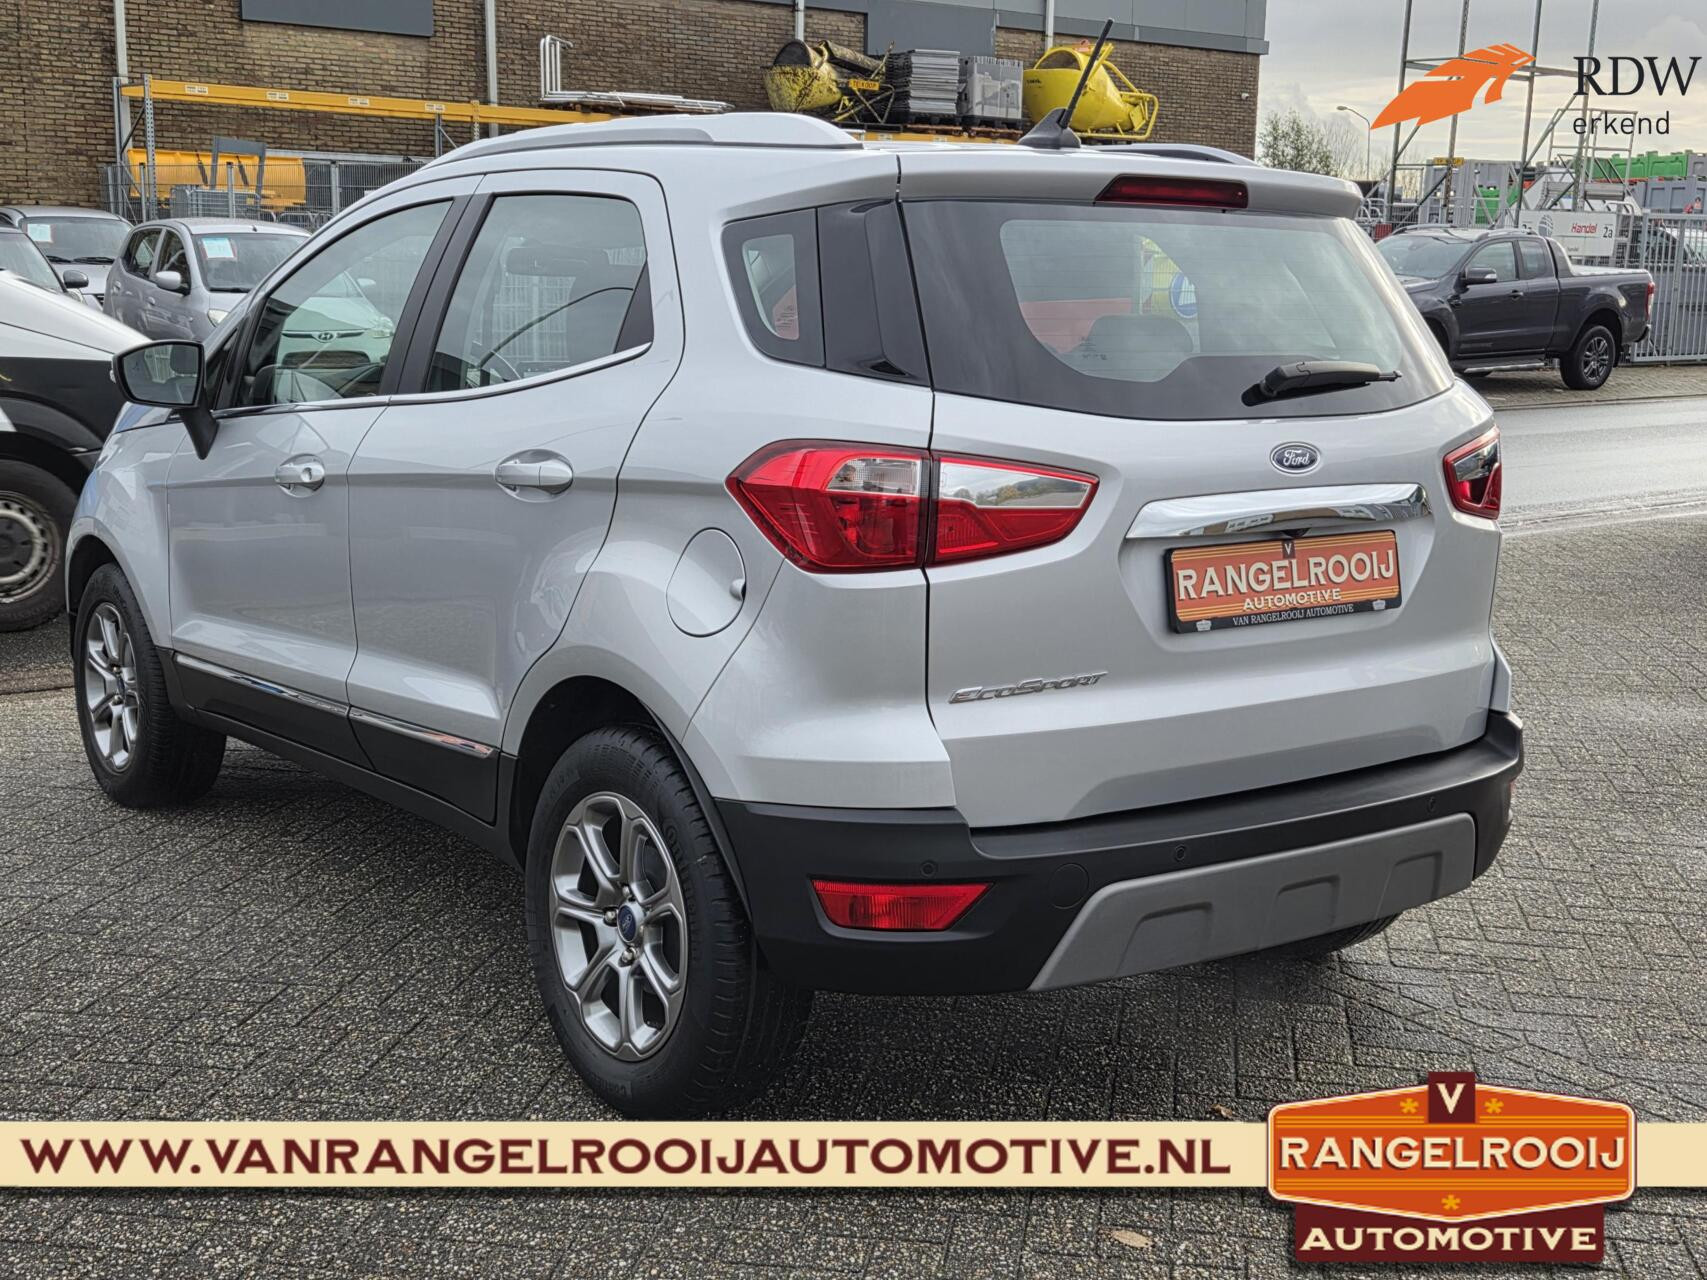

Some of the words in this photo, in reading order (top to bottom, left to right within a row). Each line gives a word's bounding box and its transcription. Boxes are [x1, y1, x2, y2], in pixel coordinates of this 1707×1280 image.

[1571, 223, 1598, 234] Handel
[1602, 226, 1613, 239] 2a
[1283, 449, 1311, 466] Ford
[1284, 542, 1293, 556] V
[1176, 550, 1395, 600] RANGELROOIJ
[1242, 588, 1342, 611] AUTOMOTIVE
[1233, 615, 1249, 626] VAN
[1250, 609, 1305, 624] RANGELROOIJ
[1305, 603, 1354, 618] AUTOMOTIVE
